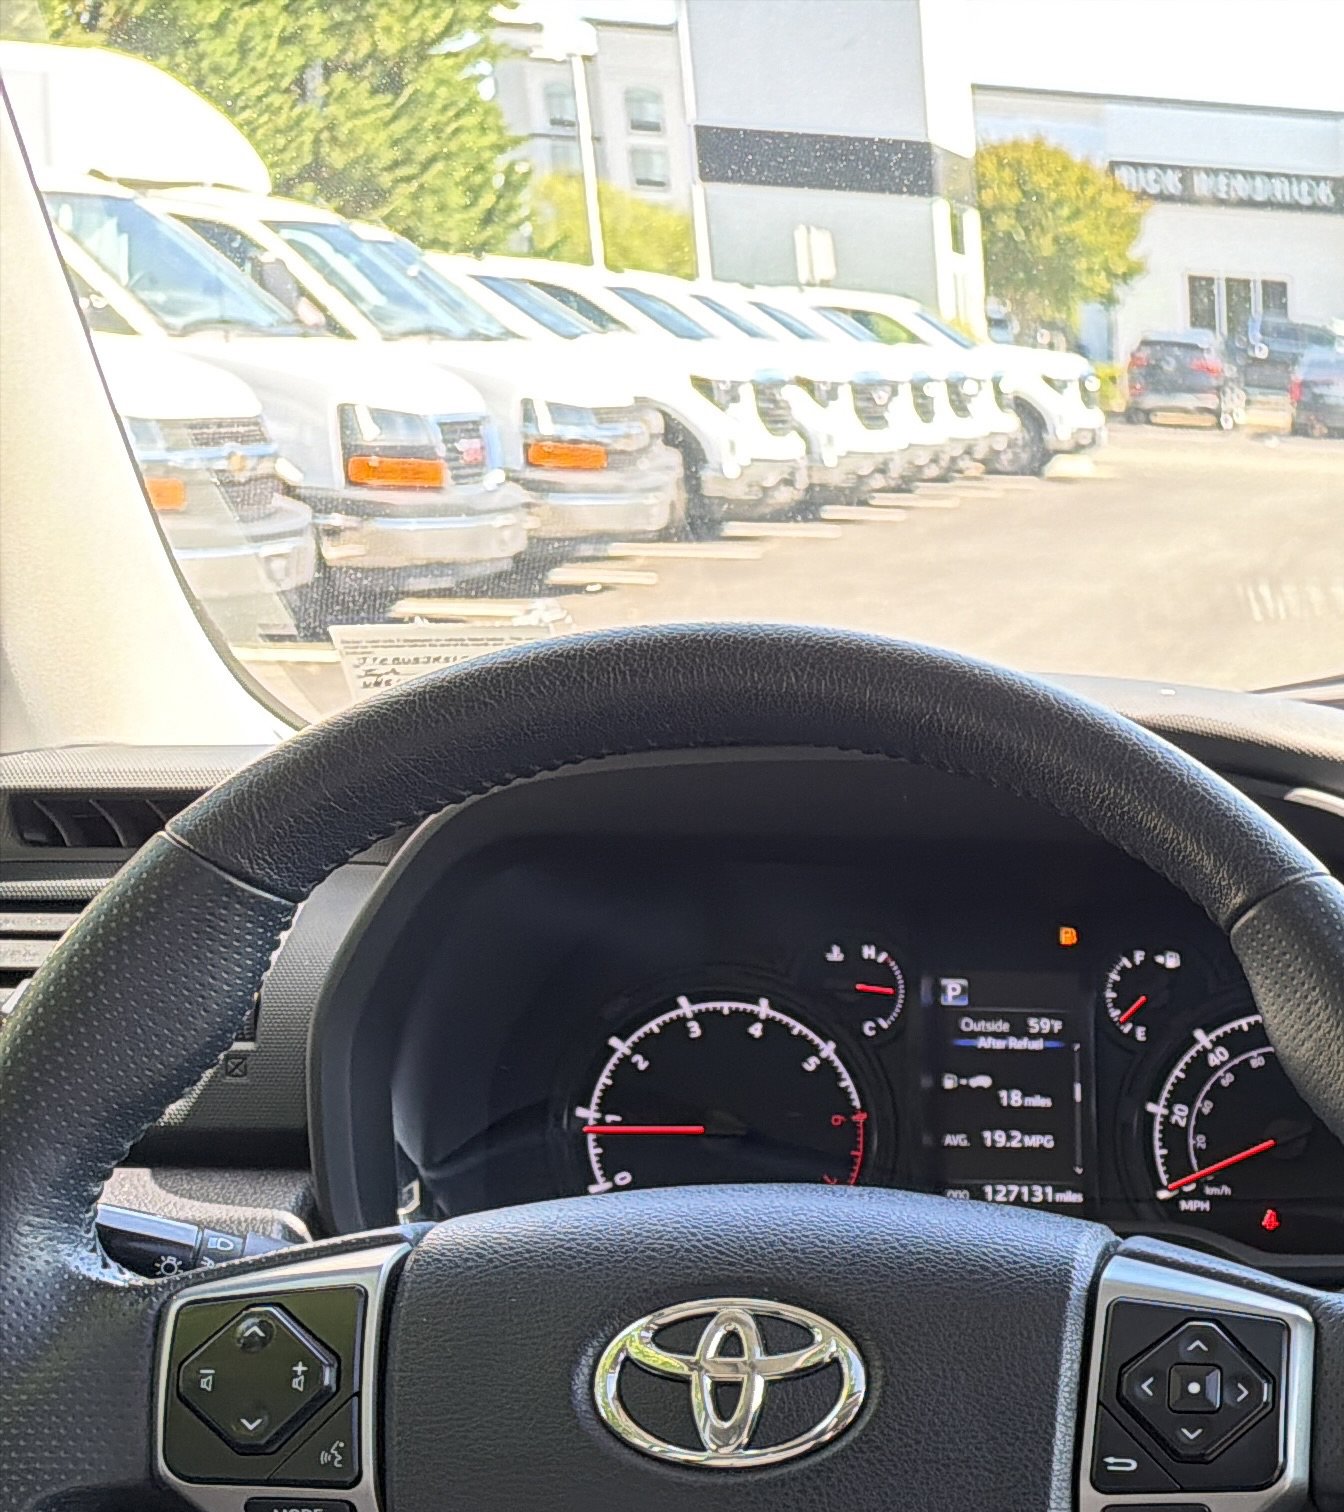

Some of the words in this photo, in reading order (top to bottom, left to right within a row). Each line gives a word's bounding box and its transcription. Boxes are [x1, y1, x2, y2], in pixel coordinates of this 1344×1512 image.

[861, 944, 876, 960] H
[1134, 949, 1146, 965] F
[947, 982, 962, 1001] P
[687, 1021, 702, 1038] 3
[748, 1022, 764, 1038] 4
[863, 1020, 877, 1036] C
[960, 1016, 1010, 1033] Outside
[1135, 1026, 1147, 1042] E
[977, 1036, 1006, 1049] After
[1008, 1036, 1044, 1050] Refuel
[631, 1054, 650, 1071] 2
[802, 1055, 821, 1072] 5
[1207, 1045, 1230, 1068] 40
[999, 1089, 1023, 1107] 18
[1023, 1095, 1052, 1108] miles
[605, 1113, 622, 1124] 1
[1169, 1103, 1189, 1128] 20
[943, 1133, 970, 1147] AVG.
[982, 1130, 1022, 1148] 19.2
[1023, 1134, 1055, 1149] MPG
[613, 1170, 633, 1187] 0
[983, 1184, 1053, 1203] 127131
[1054, 1191, 1084, 1203] miles
[1204, 1184, 1232, 1196] km/h
[1179, 1199, 1211, 1212] MPH
